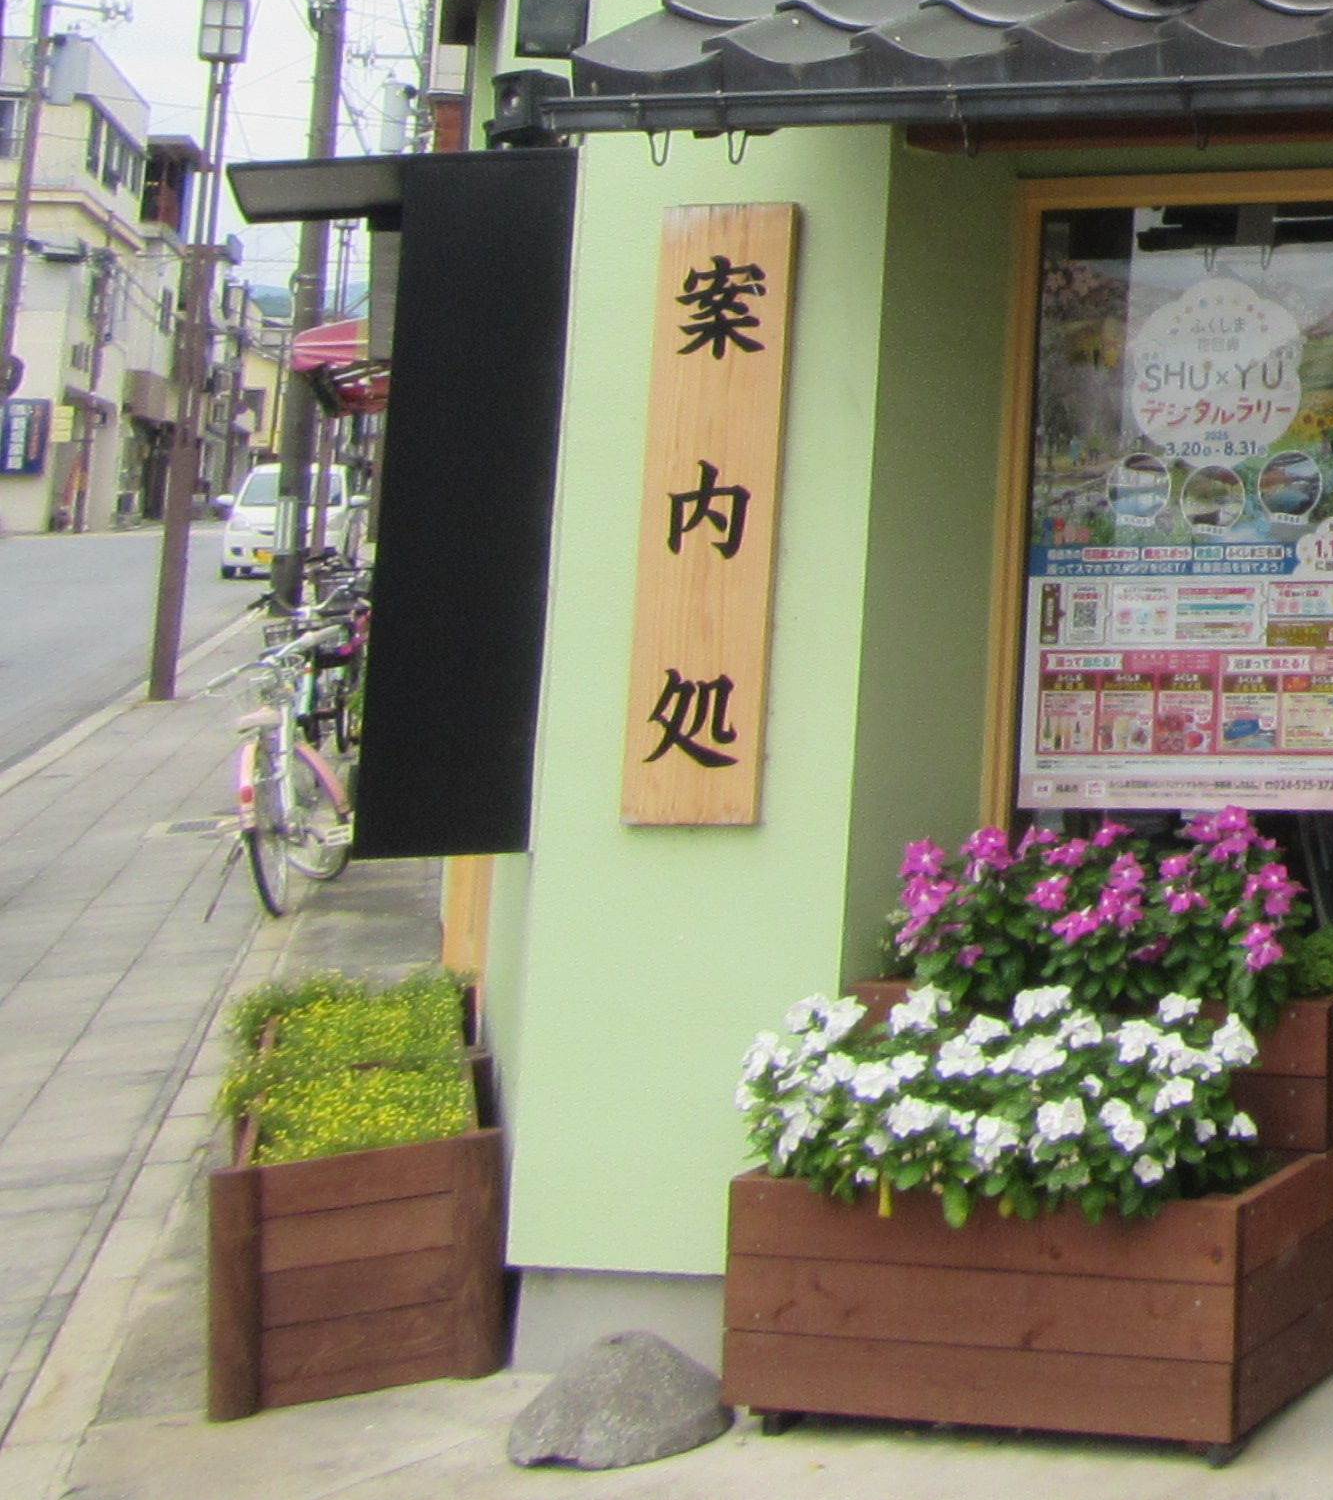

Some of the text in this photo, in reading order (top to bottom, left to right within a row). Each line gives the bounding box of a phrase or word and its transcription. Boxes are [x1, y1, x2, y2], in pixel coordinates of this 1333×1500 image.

[1190, 316, 1247, 334] ふくしま
[1140, 396, 1292, 428] デジタルラリー
[641, 254, 767, 769] 案内処
